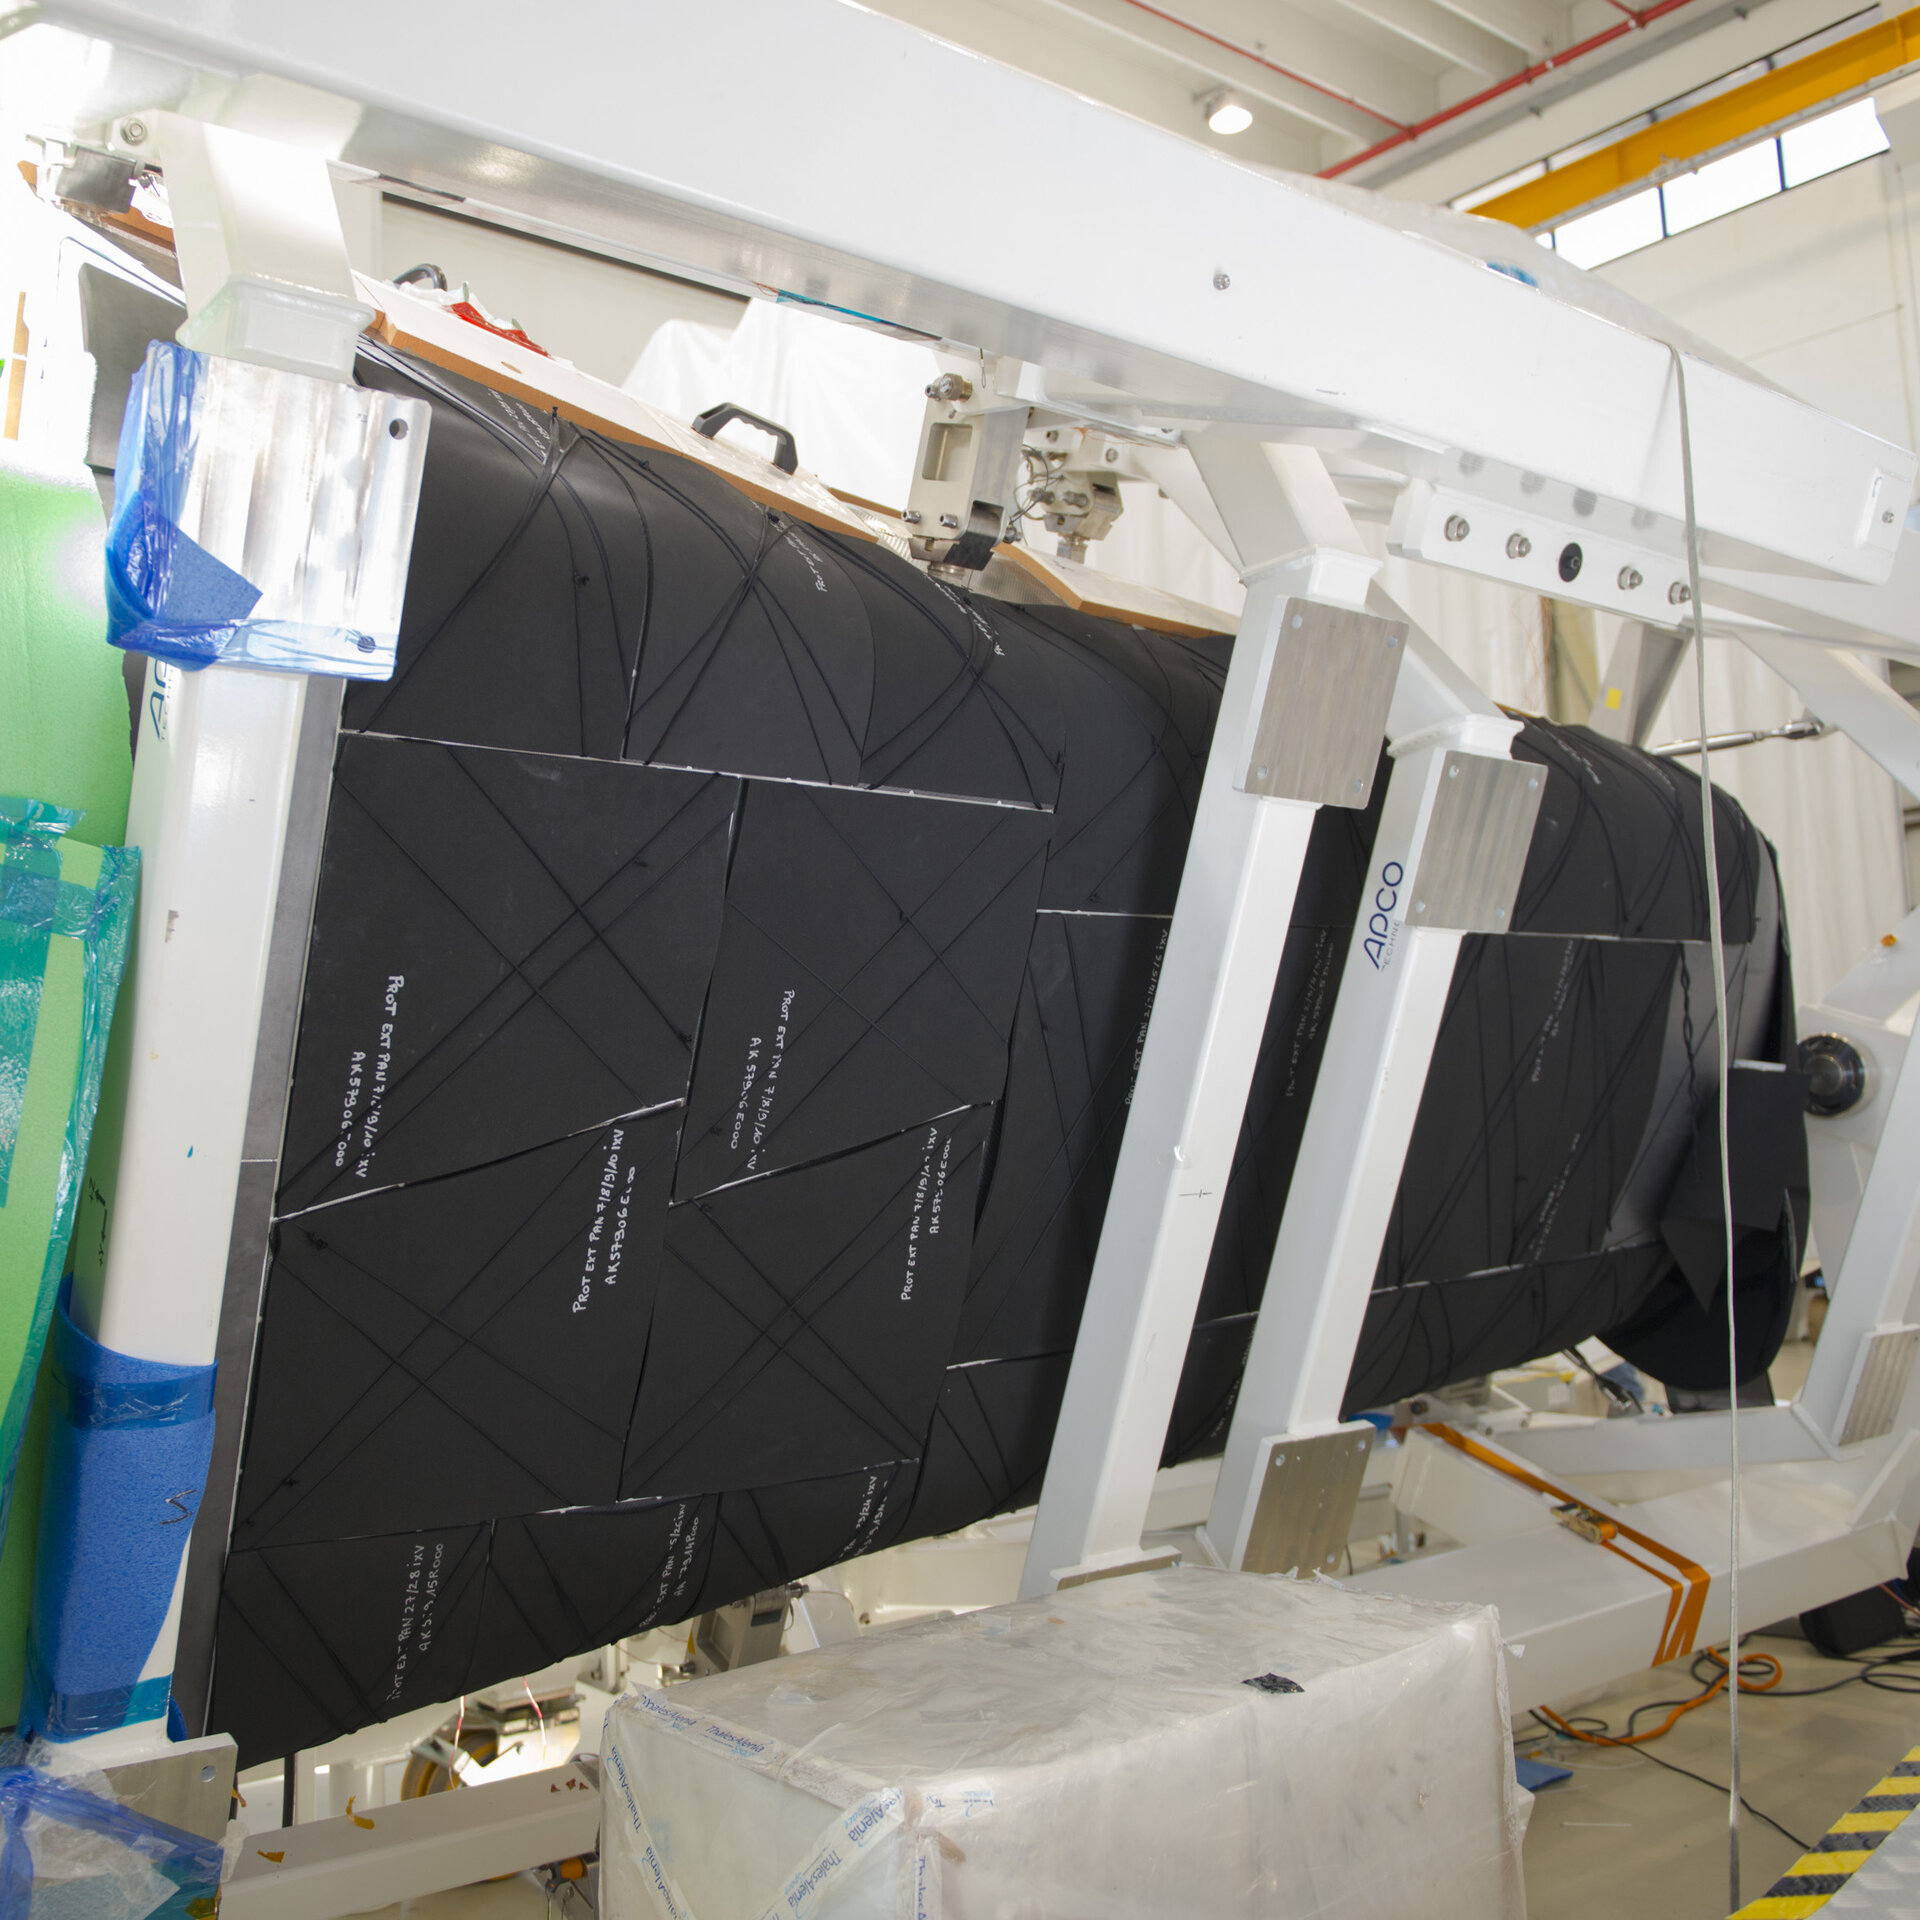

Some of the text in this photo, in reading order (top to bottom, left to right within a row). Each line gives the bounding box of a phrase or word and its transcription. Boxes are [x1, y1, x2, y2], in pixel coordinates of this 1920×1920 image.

[1363, 861, 1404, 970] APCO
[385, 975, 405, 1016] PROT
[780, 990, 796, 1021] PROT
[380, 1023, 393, 1049] EXT
[776, 1026, 787, 1049] EXT
[1137, 1022, 1147, 1043] PAN
[375, 1053, 391, 1081] PAN
[768, 1054, 782, 1079] PAN
[1133, 1048, 1143, 1071] EXT
[335, 1051, 367, 1167] AK57906000
[753, 1086, 776, 1144] 7/8/9/10
[596, 1153, 619, 1214] 7/8/9/10
[589, 1216, 605, 1242] PAN
[910, 1215, 921, 1241] PAN
[585, 1248, 597, 1272] EXT
[908, 1244, 917, 1266] EXT
[572, 1276, 591, 1313] PROT
[901, 1271, 915, 1300] PROT
[662, 1556, 675, 1578] PAN
[669, 1520, 683, 1551] 5/26
[404, 1570, 421, 1614] 27/28
[418, 1543, 444, 1651] AK5915R000
[398, 1617, 414, 1642] PAN
[611, 1746, 643, 1833] ThalesAlenia
[786, 1850, 844, 1909] ThalesAlenia
